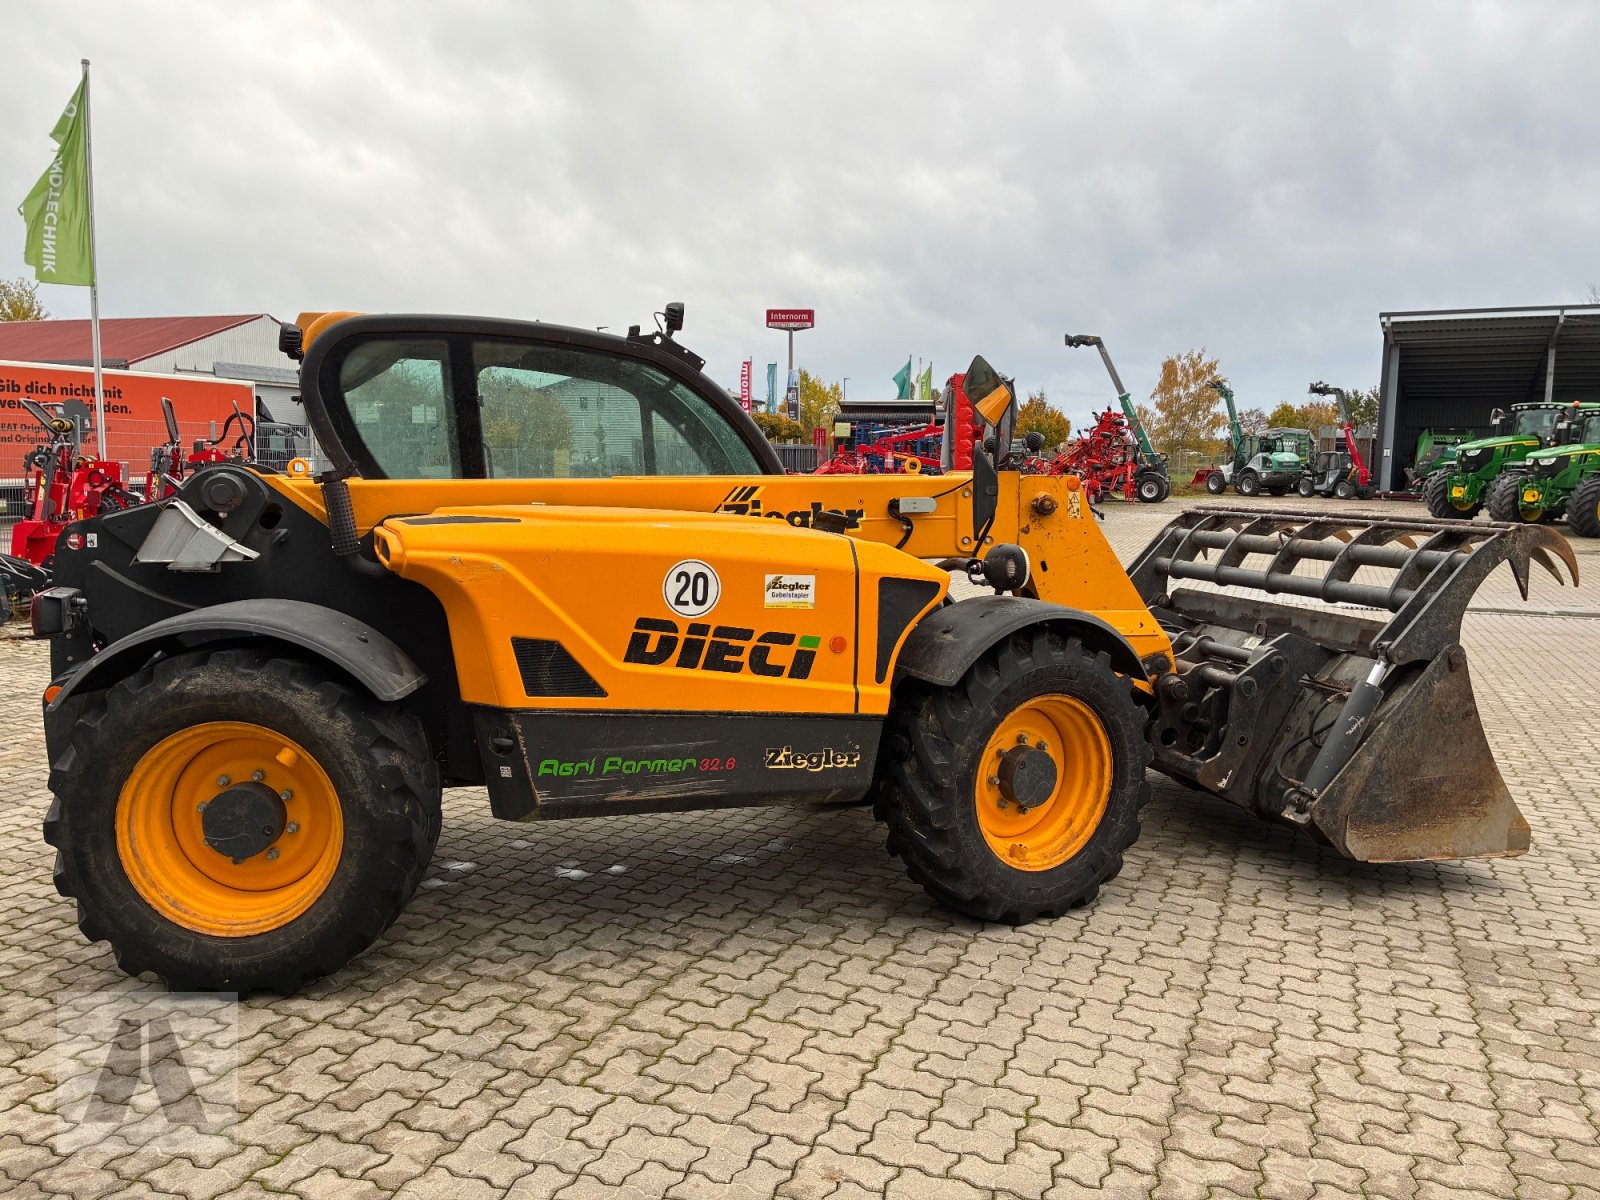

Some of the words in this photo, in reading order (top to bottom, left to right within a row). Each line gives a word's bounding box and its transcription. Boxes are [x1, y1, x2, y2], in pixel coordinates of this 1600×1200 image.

[770, 312, 809, 320] Internorm
[25, 380, 57, 395] dich
[60, 383, 96, 398] nicht
[103, 386, 123, 399] mit
[673, 570, 710, 607] 20
[771, 580, 811, 591] Ziegler
[771, 591, 809, 599] Gabelstapler
[698, 756, 737, 772] 32.6
[765, 745, 861, 772] Ziegler
